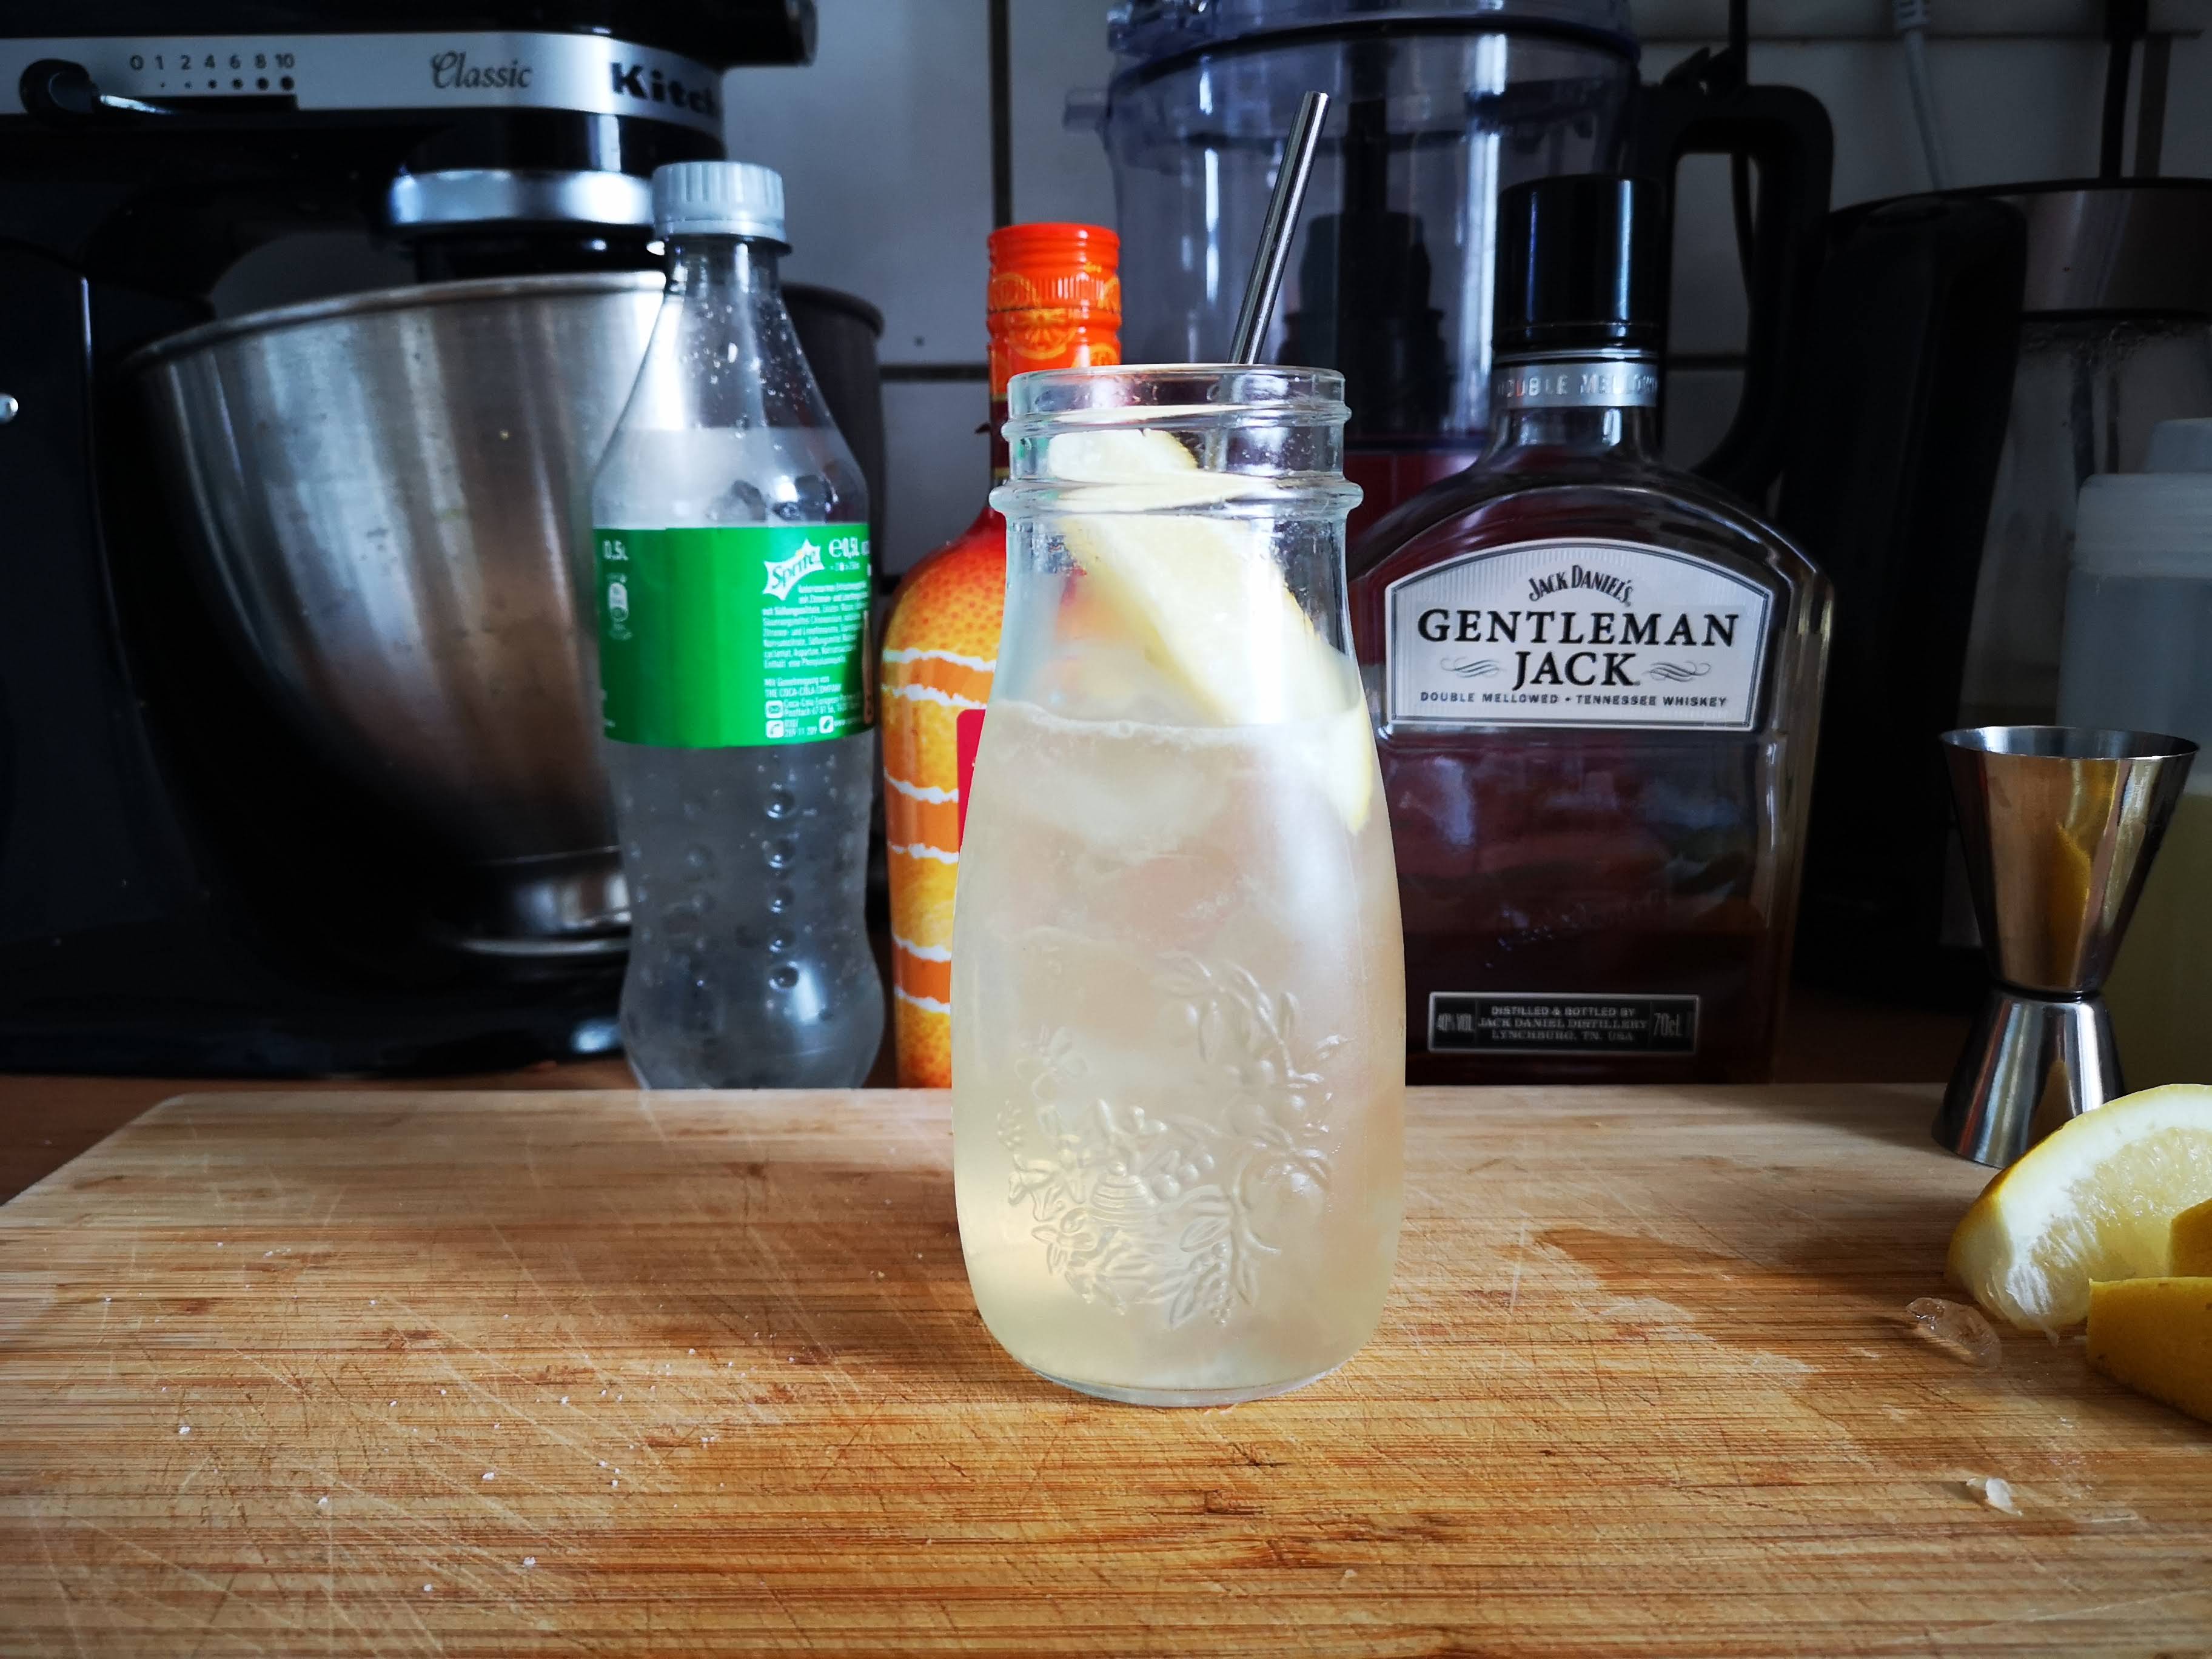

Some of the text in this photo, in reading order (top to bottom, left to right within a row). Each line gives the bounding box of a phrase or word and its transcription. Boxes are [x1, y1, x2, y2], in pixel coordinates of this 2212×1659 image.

[130, 53, 295, 70] 0 1 2 4 6 8 10
[431, 51, 533, 89] Classic
[771, 549, 817, 589] Sprite
[1528, 565, 1634, 603] JACK DANIEL'S
[1418, 608, 1739, 647] GENTLEMAN
[1512, 651, 1637, 691] JACK
[1420, 692, 1728, 707] DOUBLE MELLOWED TENNESSEE WHISKEY
[1478, 1017, 1647, 1029] JACK DANIEL DISTILLERY
[1491, 1005, 1549, 1016] DISTILLED
[1564, 1007, 1617, 1017] BOTTLED
